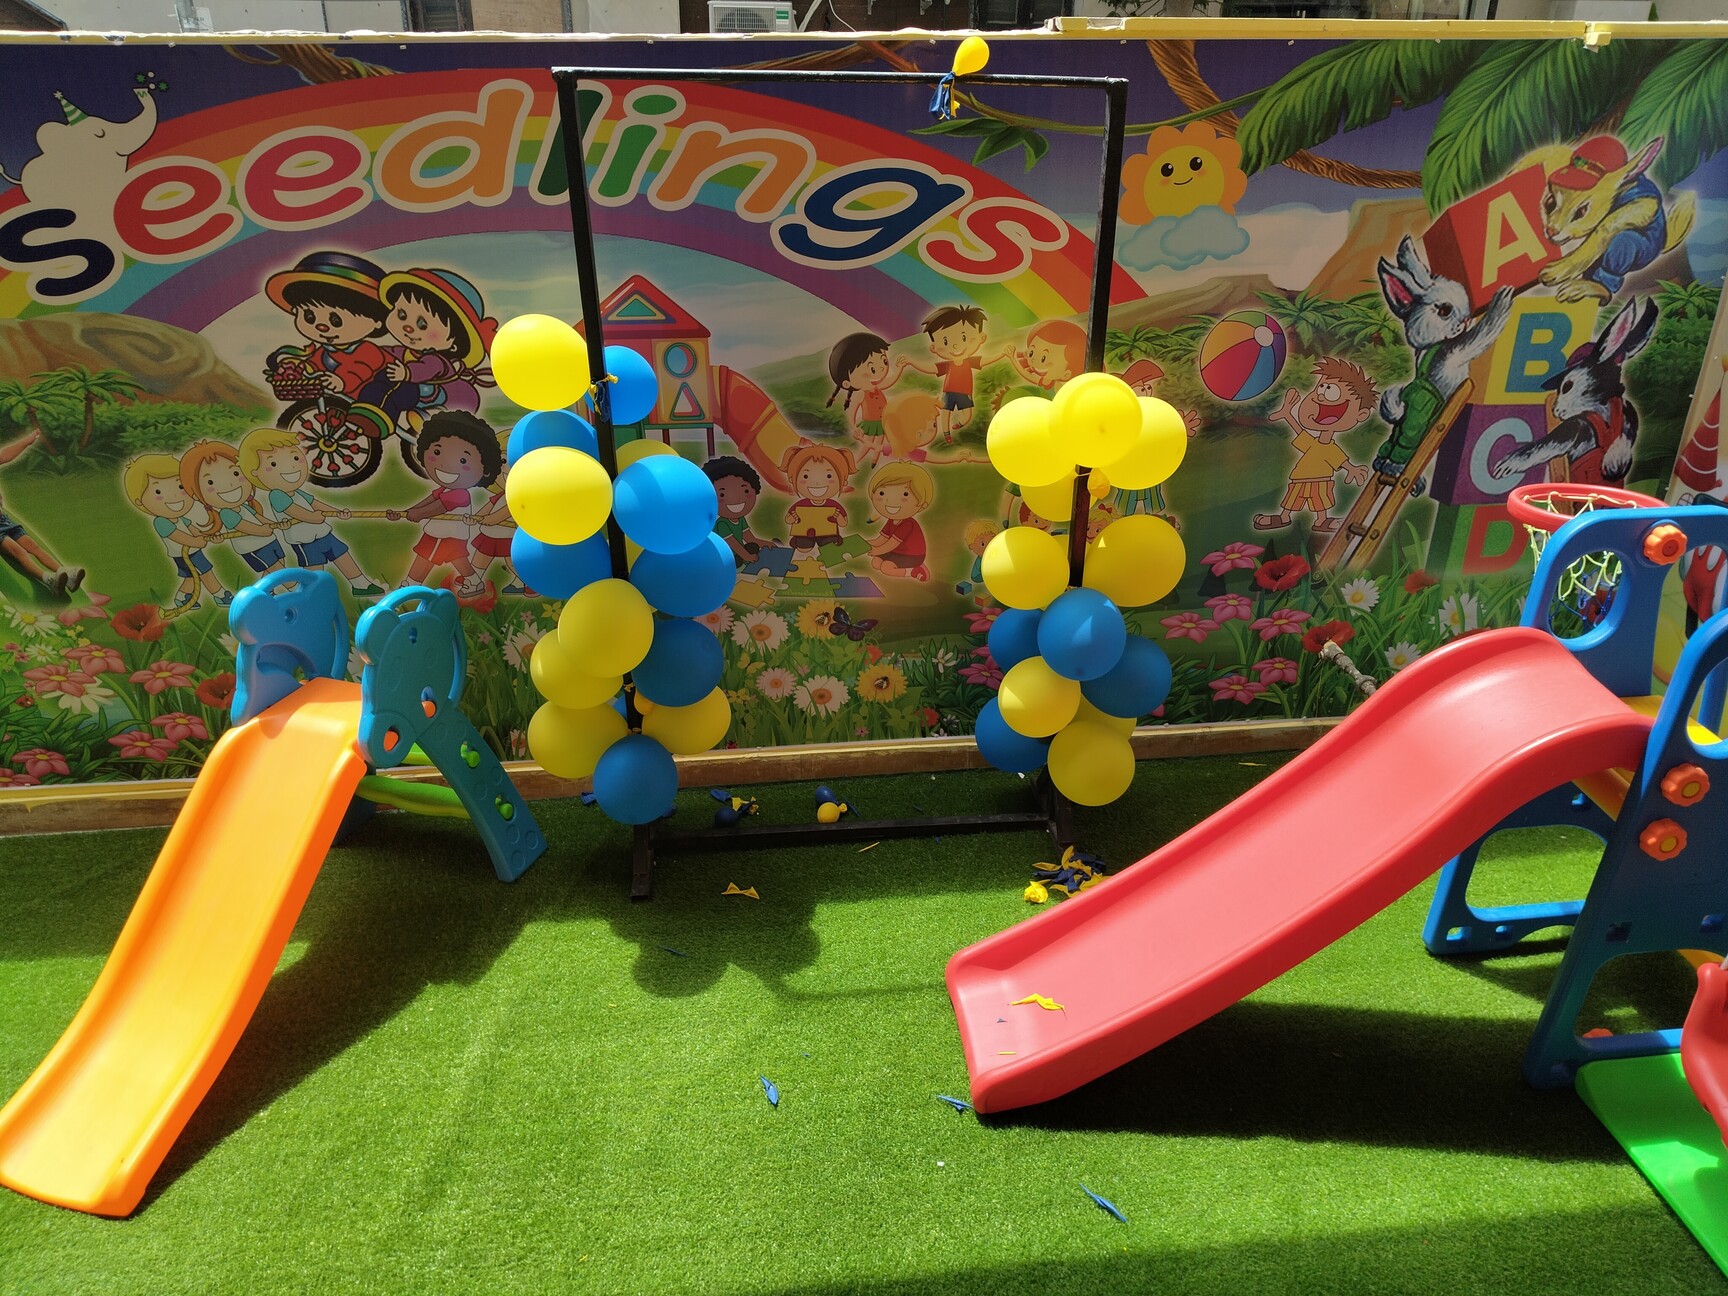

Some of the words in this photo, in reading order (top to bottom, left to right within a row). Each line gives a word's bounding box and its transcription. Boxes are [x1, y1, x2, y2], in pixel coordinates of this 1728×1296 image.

[1481, 191, 1548, 289] A
[1505, 312, 1573, 393] B
[1470, 418, 1534, 495] C
[1461, 504, 1530, 574] D
